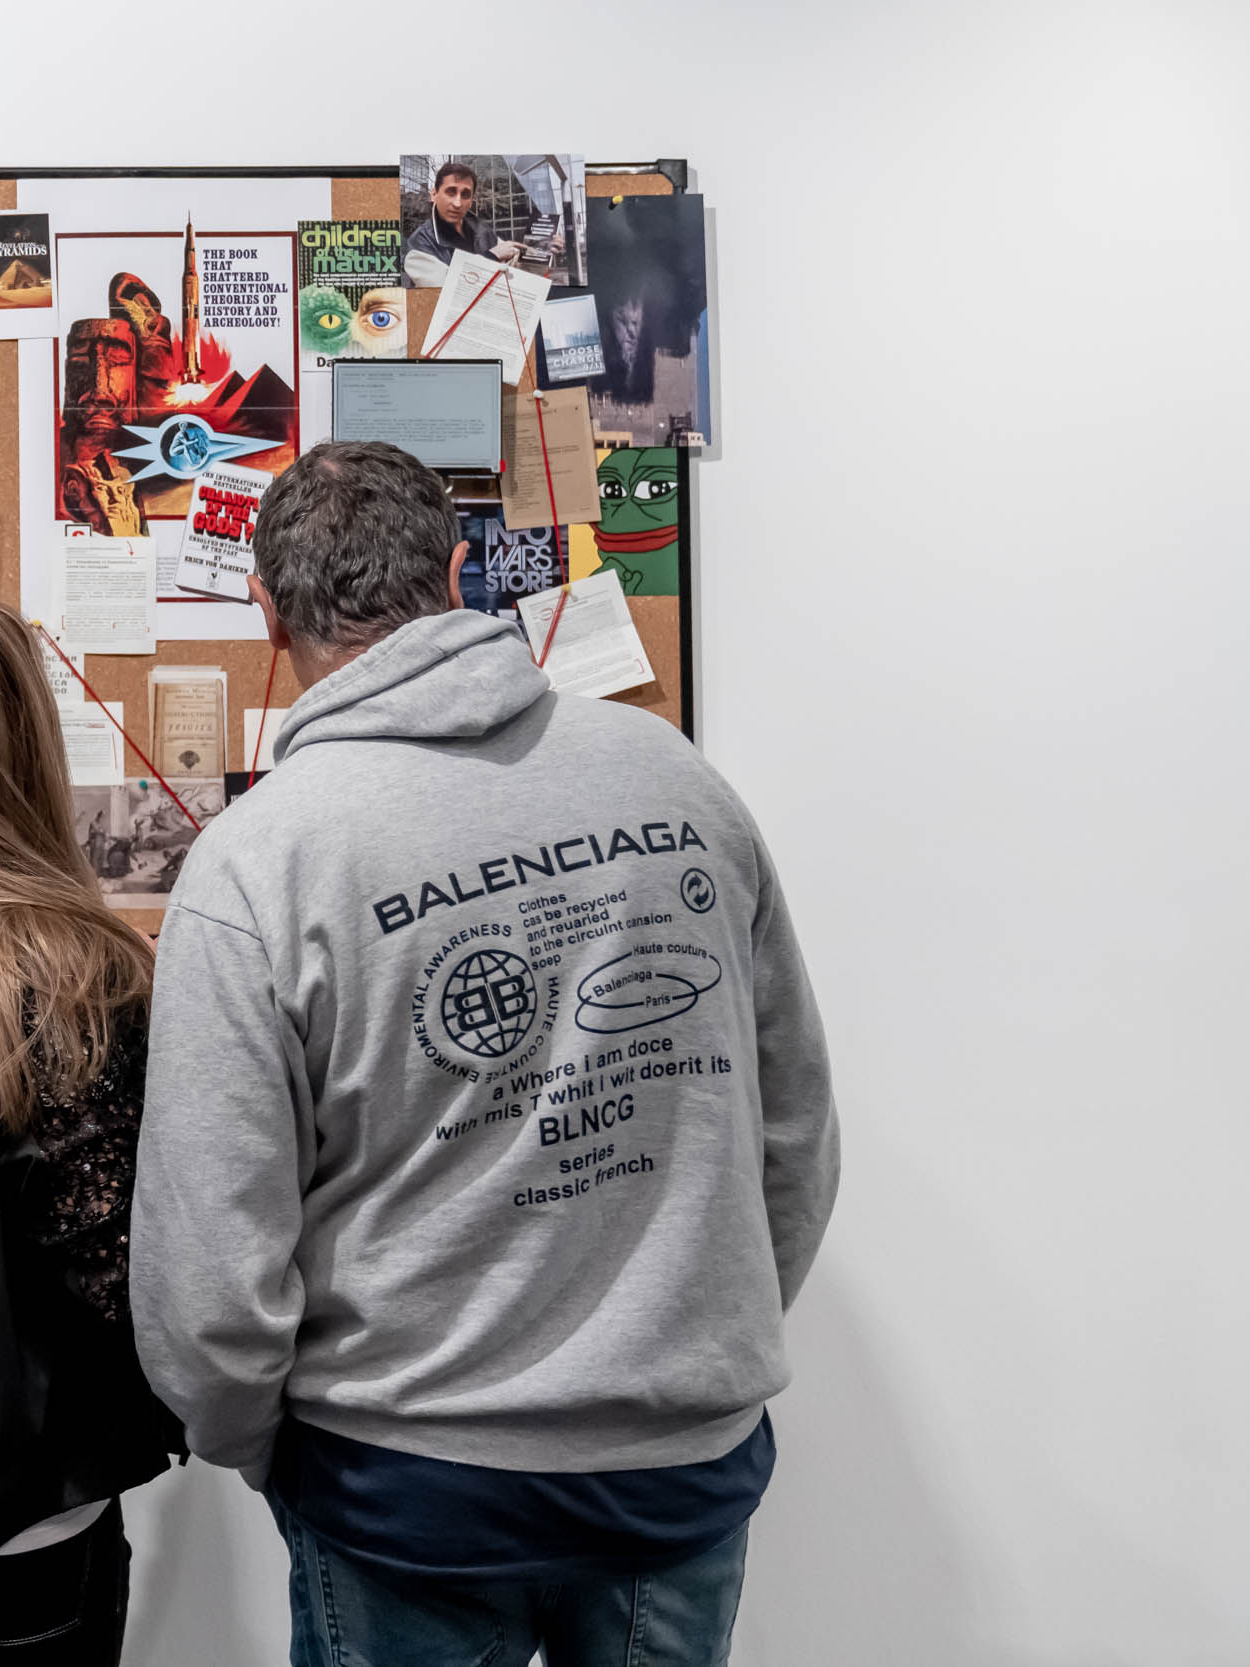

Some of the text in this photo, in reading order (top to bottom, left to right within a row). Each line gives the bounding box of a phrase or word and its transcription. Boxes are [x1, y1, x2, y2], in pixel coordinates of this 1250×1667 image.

[302, 224, 401, 249] children
[203, 249, 258, 259] THE BOOK
[313, 251, 397, 272] matrix
[203, 261, 232, 271] THAT
[203, 272, 269, 282] SHATTERED
[203, 283, 288, 293] CONVENTIONAL
[203, 294, 277, 305] THEORIES OF
[204, 306, 278, 316] HISTORY AND
[204, 317, 281, 328] ARCHEOLOGY!
[553, 353, 601, 367] CHANGE
[561, 344, 600, 357] LOOSE
[214, 480, 252, 493] BESTSELLER
[216, 473, 265, 489] INTERNATIONAL
[198, 485, 260, 512] CHARIOTS
[205, 500, 251, 522] OF THE
[485, 518, 552, 545] INFO
[485, 544, 553, 571] WARS
[485, 571, 553, 593] STORE
[372, 821, 708, 935] BALENCIAGA
[518, 893, 567, 914] Clothes
[544, 909, 562, 921] be
[566, 889, 628, 916] recycled
[527, 926, 547, 942] and
[529, 946, 542, 957] to
[543, 938, 564, 952] the
[632, 942, 708, 959] Haute couture
[592, 970, 653, 998] Balenciaga
[412, 923, 512, 1084] ENVIROMENTAL AWARENESS
[542, 976, 560, 1032] HAUTE
[645, 994, 671, 1008] Paris
[493, 1086, 504, 1101] a
[511, 1062, 576, 1094] Where
[597, 1048, 623, 1069] am
[628, 1037, 674, 1059] doce
[548, 1078, 595, 1105] whit
[610, 1066, 636, 1088] wit
[640, 1056, 703, 1080] doerit
[710, 1055, 733, 1074] its
[539, 1093, 635, 1147] BLNCG
[559, 1143, 615, 1174] series
[513, 1153, 655, 1207] classic french
